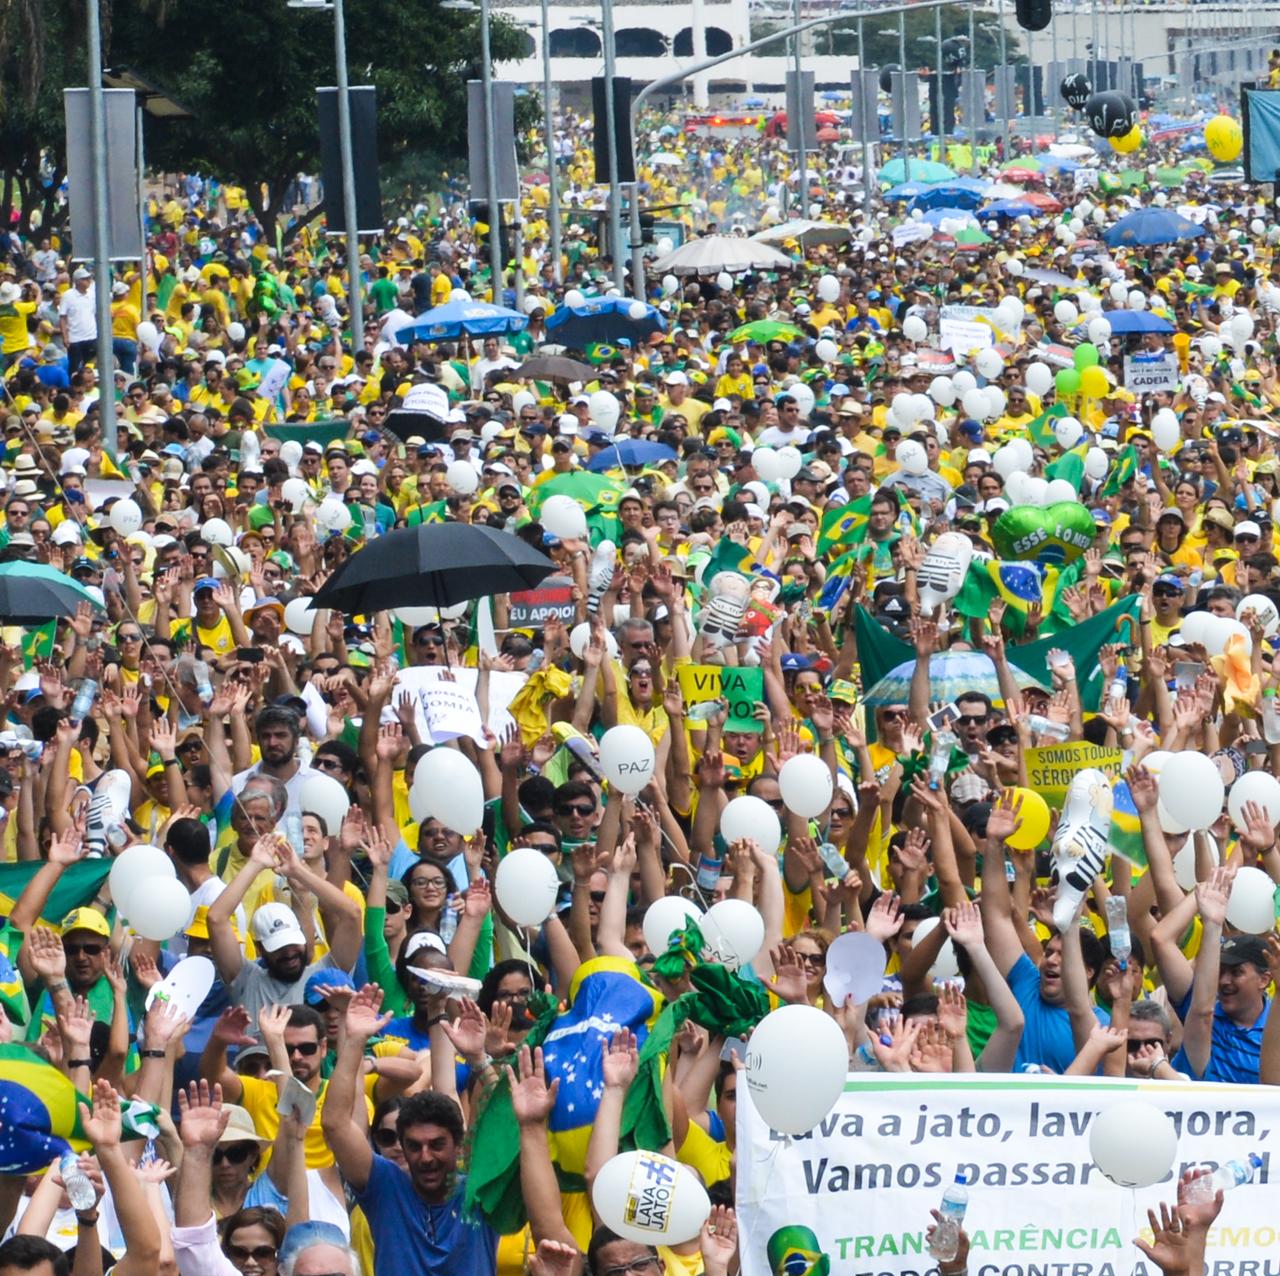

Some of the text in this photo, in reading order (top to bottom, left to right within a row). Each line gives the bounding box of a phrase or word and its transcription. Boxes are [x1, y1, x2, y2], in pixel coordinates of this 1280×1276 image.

[1133, 375, 1169, 387] CADEIA
[1013, 527, 1048, 554] ESSE
[510, 608, 526, 621] EU
[694, 673, 746, 692] VIVA
[618, 759, 651, 775] PAZ
[1038, 750, 1080, 764] SOMOS
[1032, 766, 1077, 786] SÉRGI
[877, 1114, 904, 1137] a
[910, 1104, 1012, 1147] jato,
[1028, 1102, 1095, 1137] lav
[1165, 1108, 1271, 1141] gora,
[802, 1157, 942, 1195] Vamos
[956, 1155, 1096, 1190] passar
[637, 1185, 670, 1232] LAVA JATO
[837, 1222, 1123, 1262] TRANARÊNCIA
